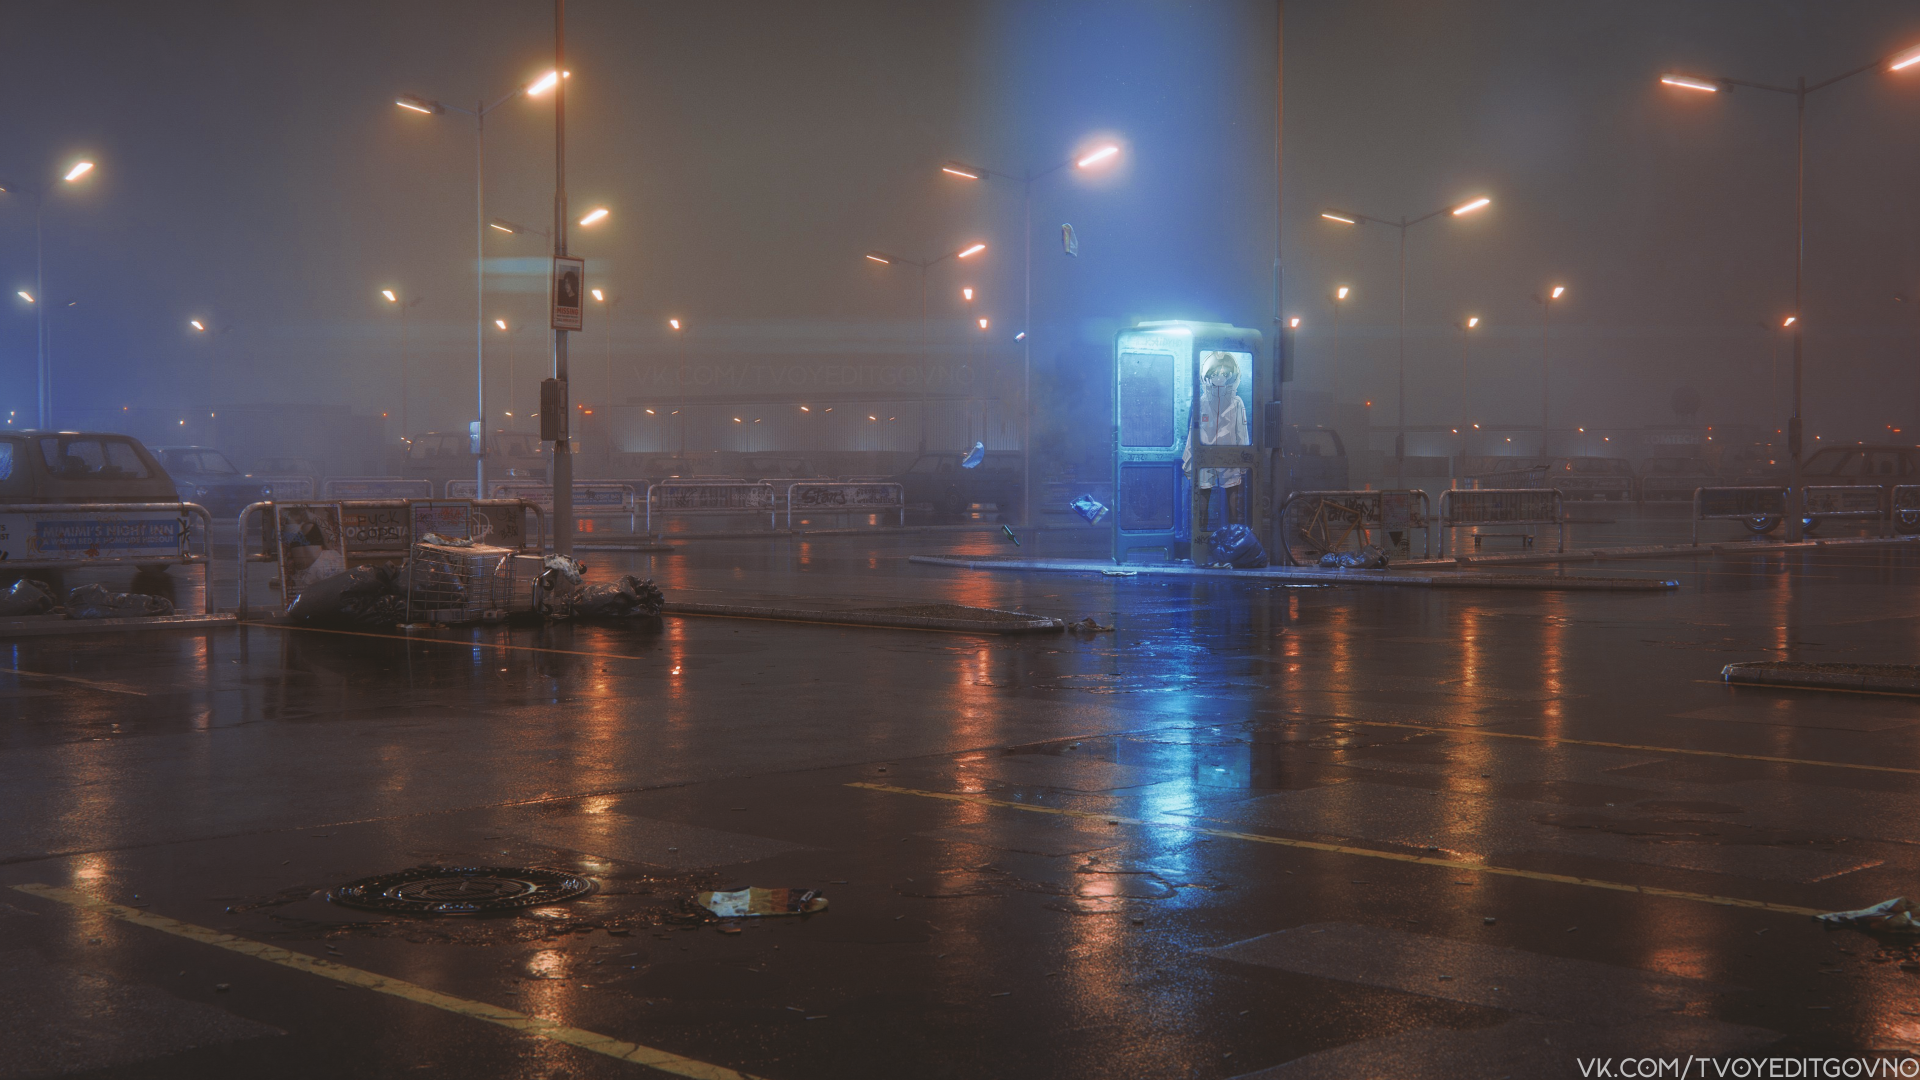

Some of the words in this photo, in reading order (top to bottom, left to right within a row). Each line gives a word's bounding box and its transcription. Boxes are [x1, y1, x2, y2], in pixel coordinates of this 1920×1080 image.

[557, 307, 578, 315] MISSING
[43, 526, 102, 538] MIMIMI'S
[107, 525, 146, 536] NIGHT
[150, 524, 174, 535] INN
[357, 527, 399, 542] COPS
